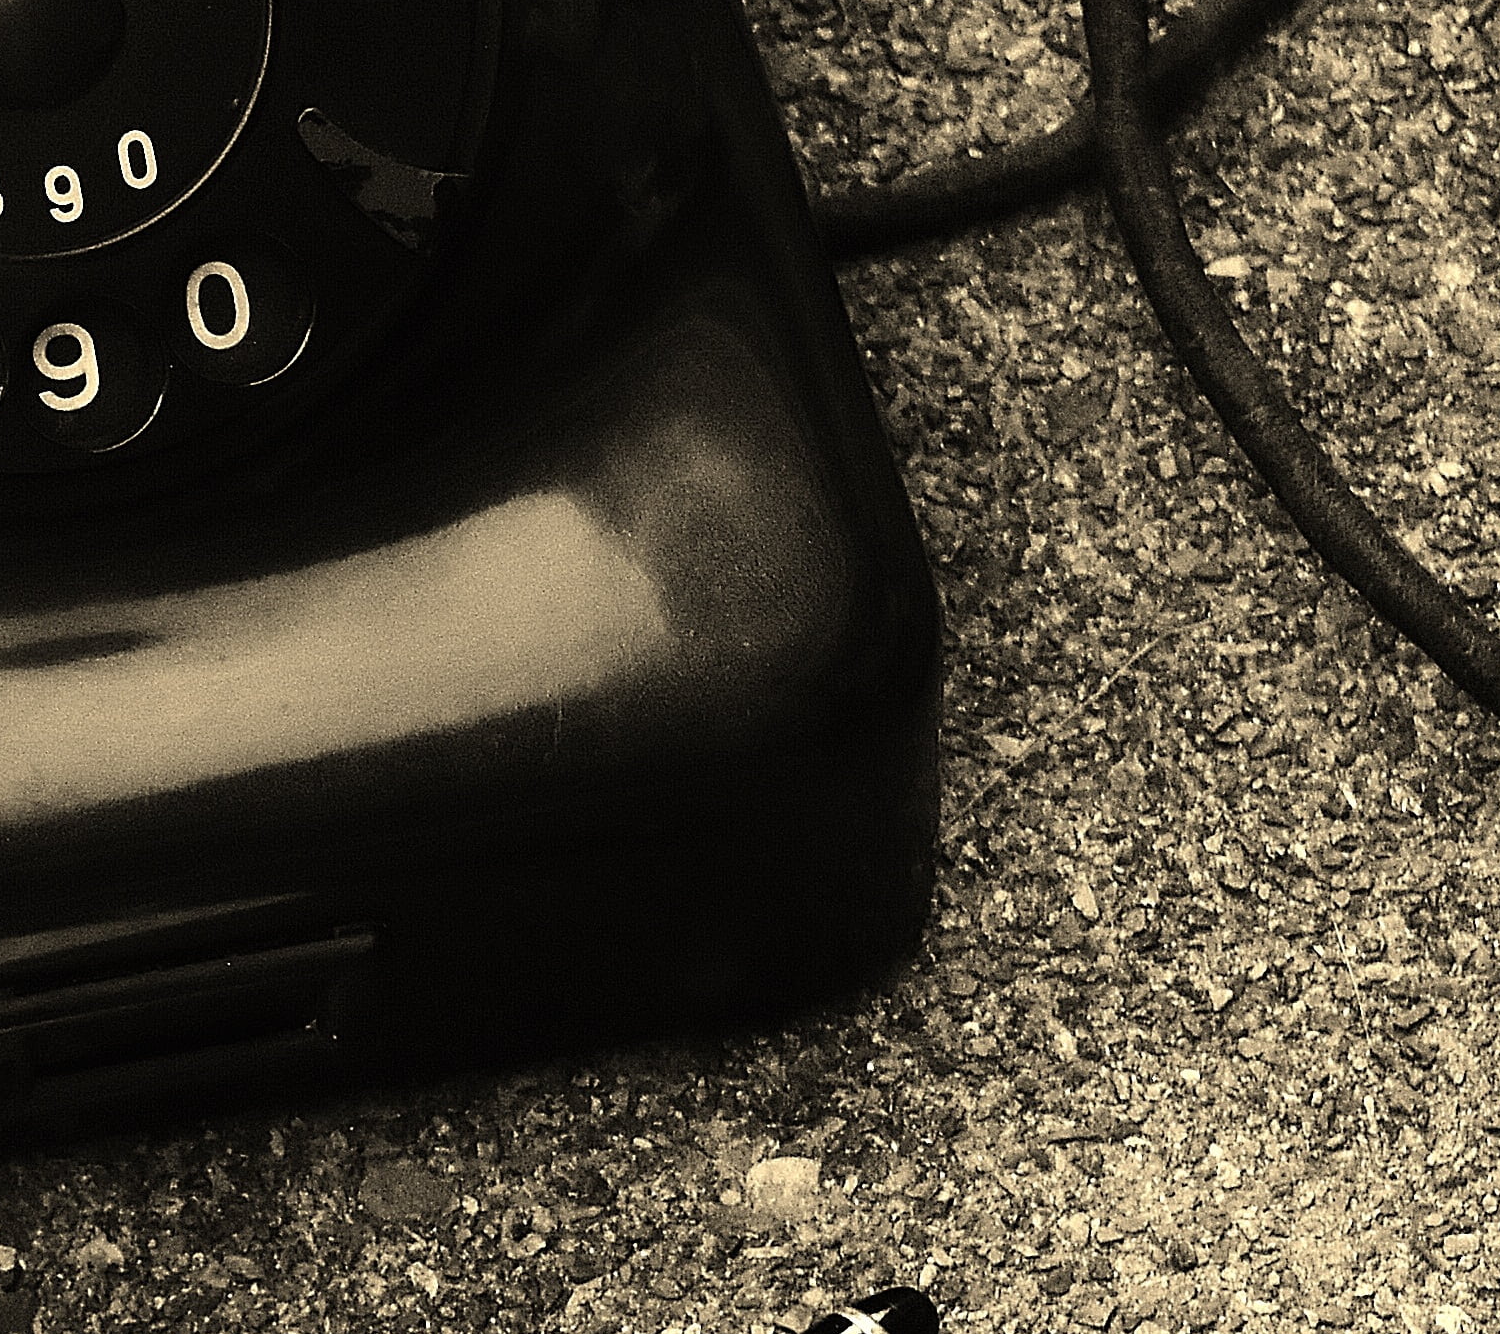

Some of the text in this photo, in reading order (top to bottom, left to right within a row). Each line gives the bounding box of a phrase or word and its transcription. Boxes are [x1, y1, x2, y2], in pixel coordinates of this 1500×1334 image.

[44, 165, 84, 223] 9
[117, 129, 158, 190] 0
[186, 261, 250, 350] 0
[32, 322, 100, 412] 9
